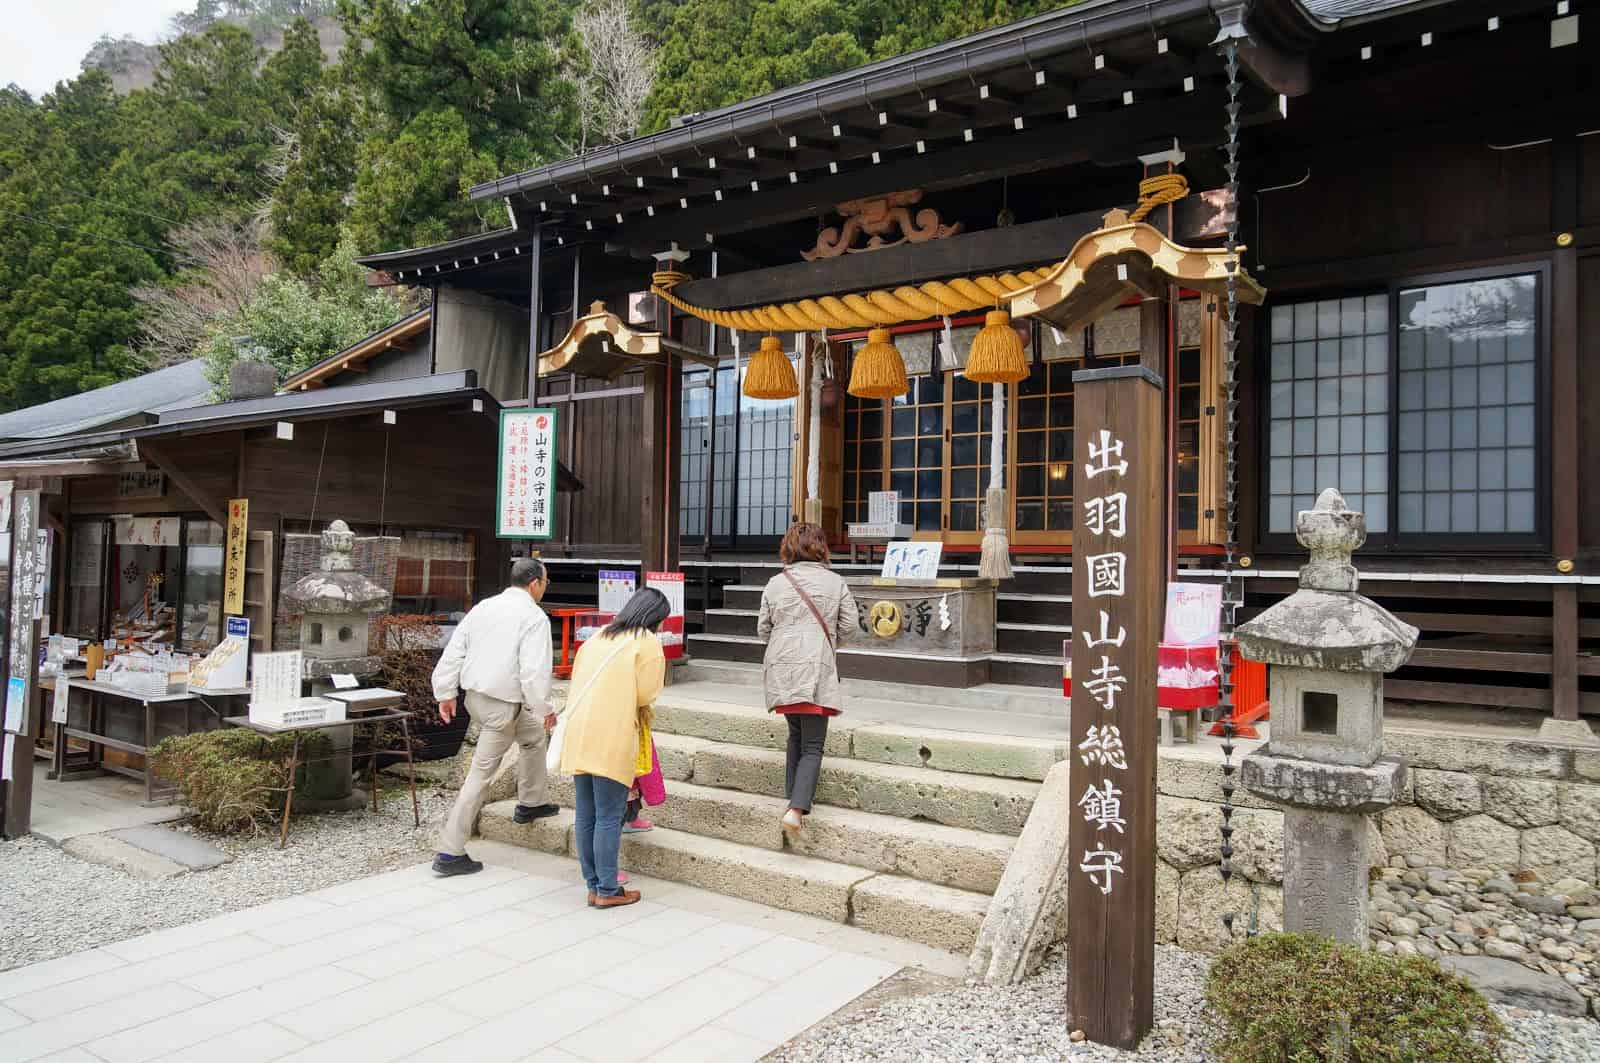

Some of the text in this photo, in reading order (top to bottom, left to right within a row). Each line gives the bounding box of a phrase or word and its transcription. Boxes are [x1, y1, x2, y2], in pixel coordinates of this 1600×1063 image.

[532, 432, 548, 532] 山寺の守護神
[1077, 428, 1129, 895] 出羽國山寺総鎮守
